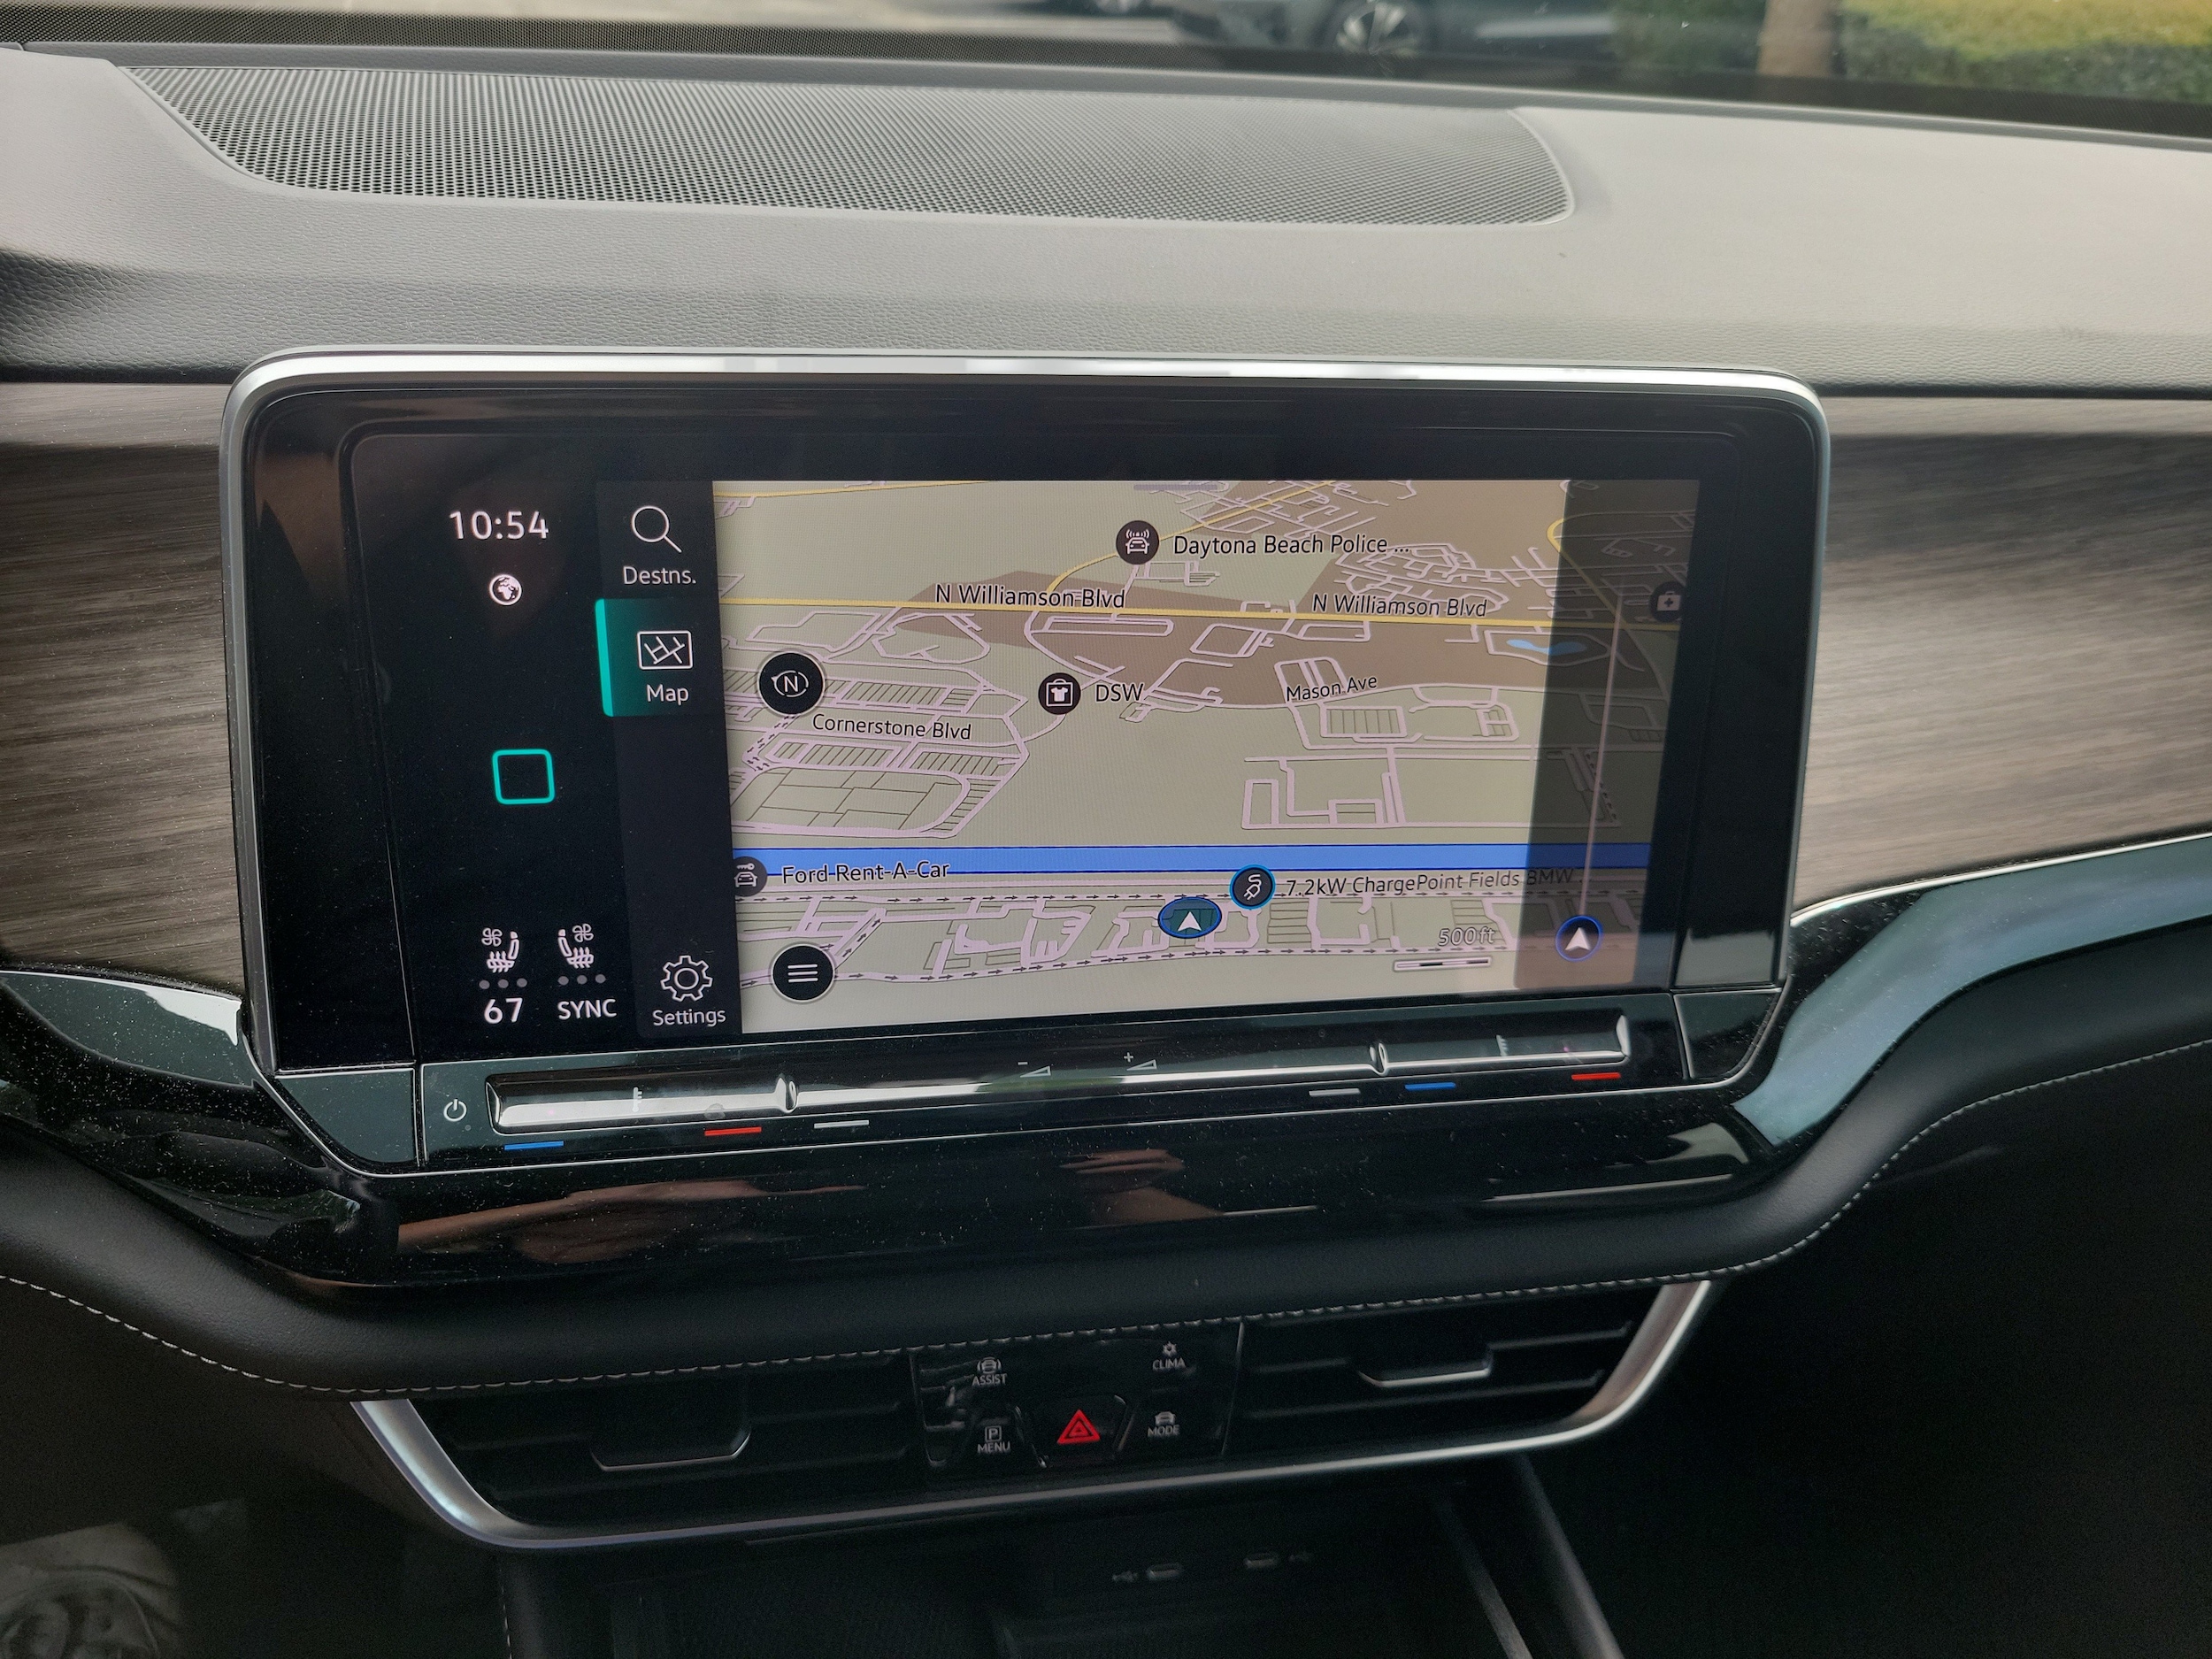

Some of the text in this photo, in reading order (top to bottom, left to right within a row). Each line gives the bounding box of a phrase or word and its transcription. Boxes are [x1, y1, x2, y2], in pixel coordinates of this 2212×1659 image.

[449, 510, 549, 541] 10:54
[1174, 535, 1256, 559] Daytona
[1264, 534, 1324, 554] Beach
[1331, 534, 1387, 554] Police
[623, 565, 696, 587] Destns.
[935, 584, 1125, 609] N Williamson Blvd
[1312, 594, 1488, 618] N Williamson Blvd
[646, 684, 689, 706] Map
[784, 675, 799, 694] N
[1095, 684, 1144, 703] DSW
[1286, 676, 1378, 702] Mason Ave
[812, 713, 972, 741] Cornerstone Blvd
[781, 861, 950, 885] Ford Rent-A-Car
[1285, 868, 1575, 896] 7.2kW ChargePoint Fields BMW
[483, 997, 523, 1025] 67
[557, 998, 618, 1021] SYNC
[652, 1006, 726, 1028] Settings
[1153, 1357, 1185, 1370] CLIMA
[972, 1372, 1007, 1386] ASSIST
[1148, 1425, 1180, 1437] MODE
[978, 1441, 1010, 1454] MENU
